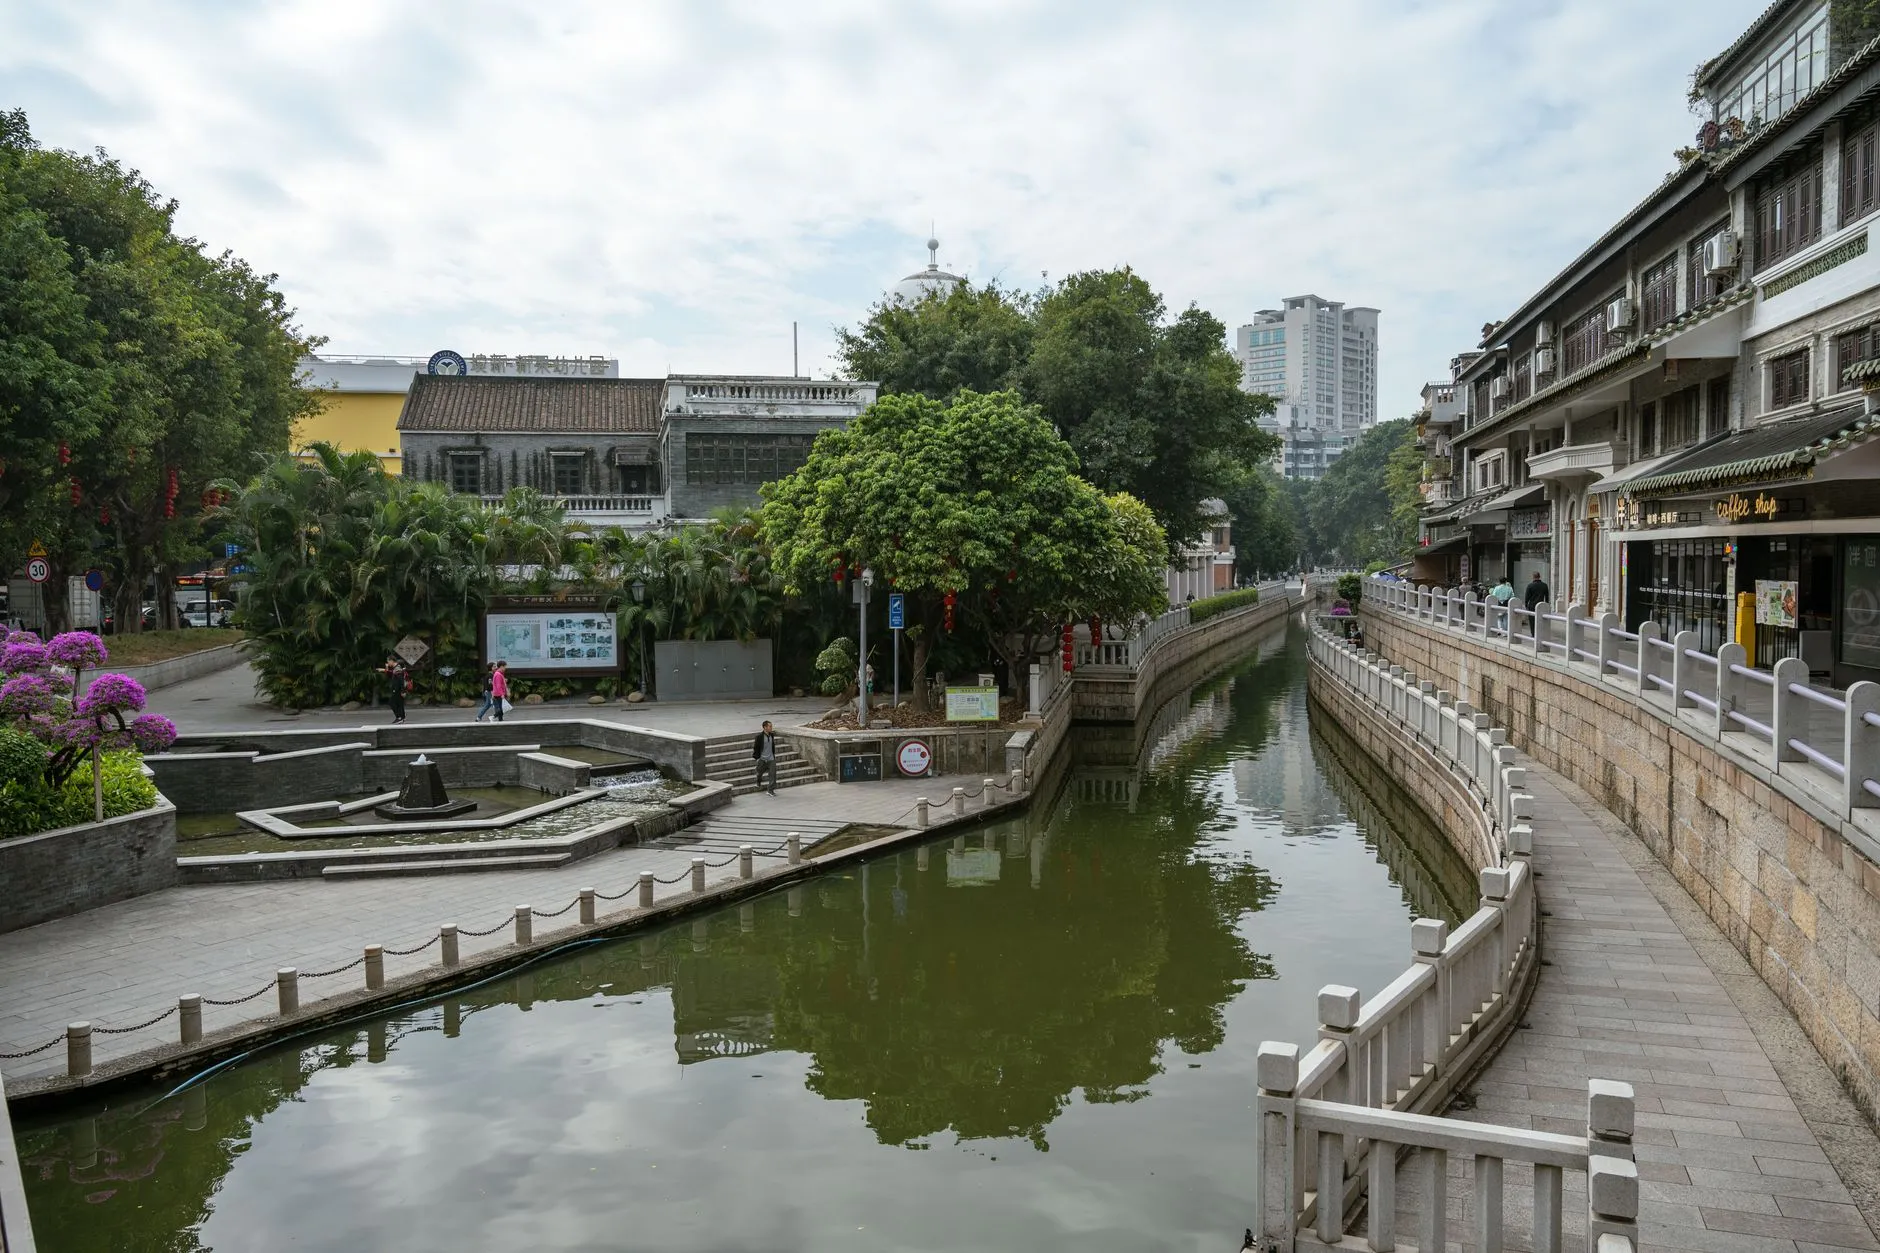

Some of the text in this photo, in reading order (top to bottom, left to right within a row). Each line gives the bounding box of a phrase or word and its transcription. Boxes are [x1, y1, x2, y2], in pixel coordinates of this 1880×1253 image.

[1717, 492, 1777, 521] coffee shop
[32, 564, 45, 577] 30
